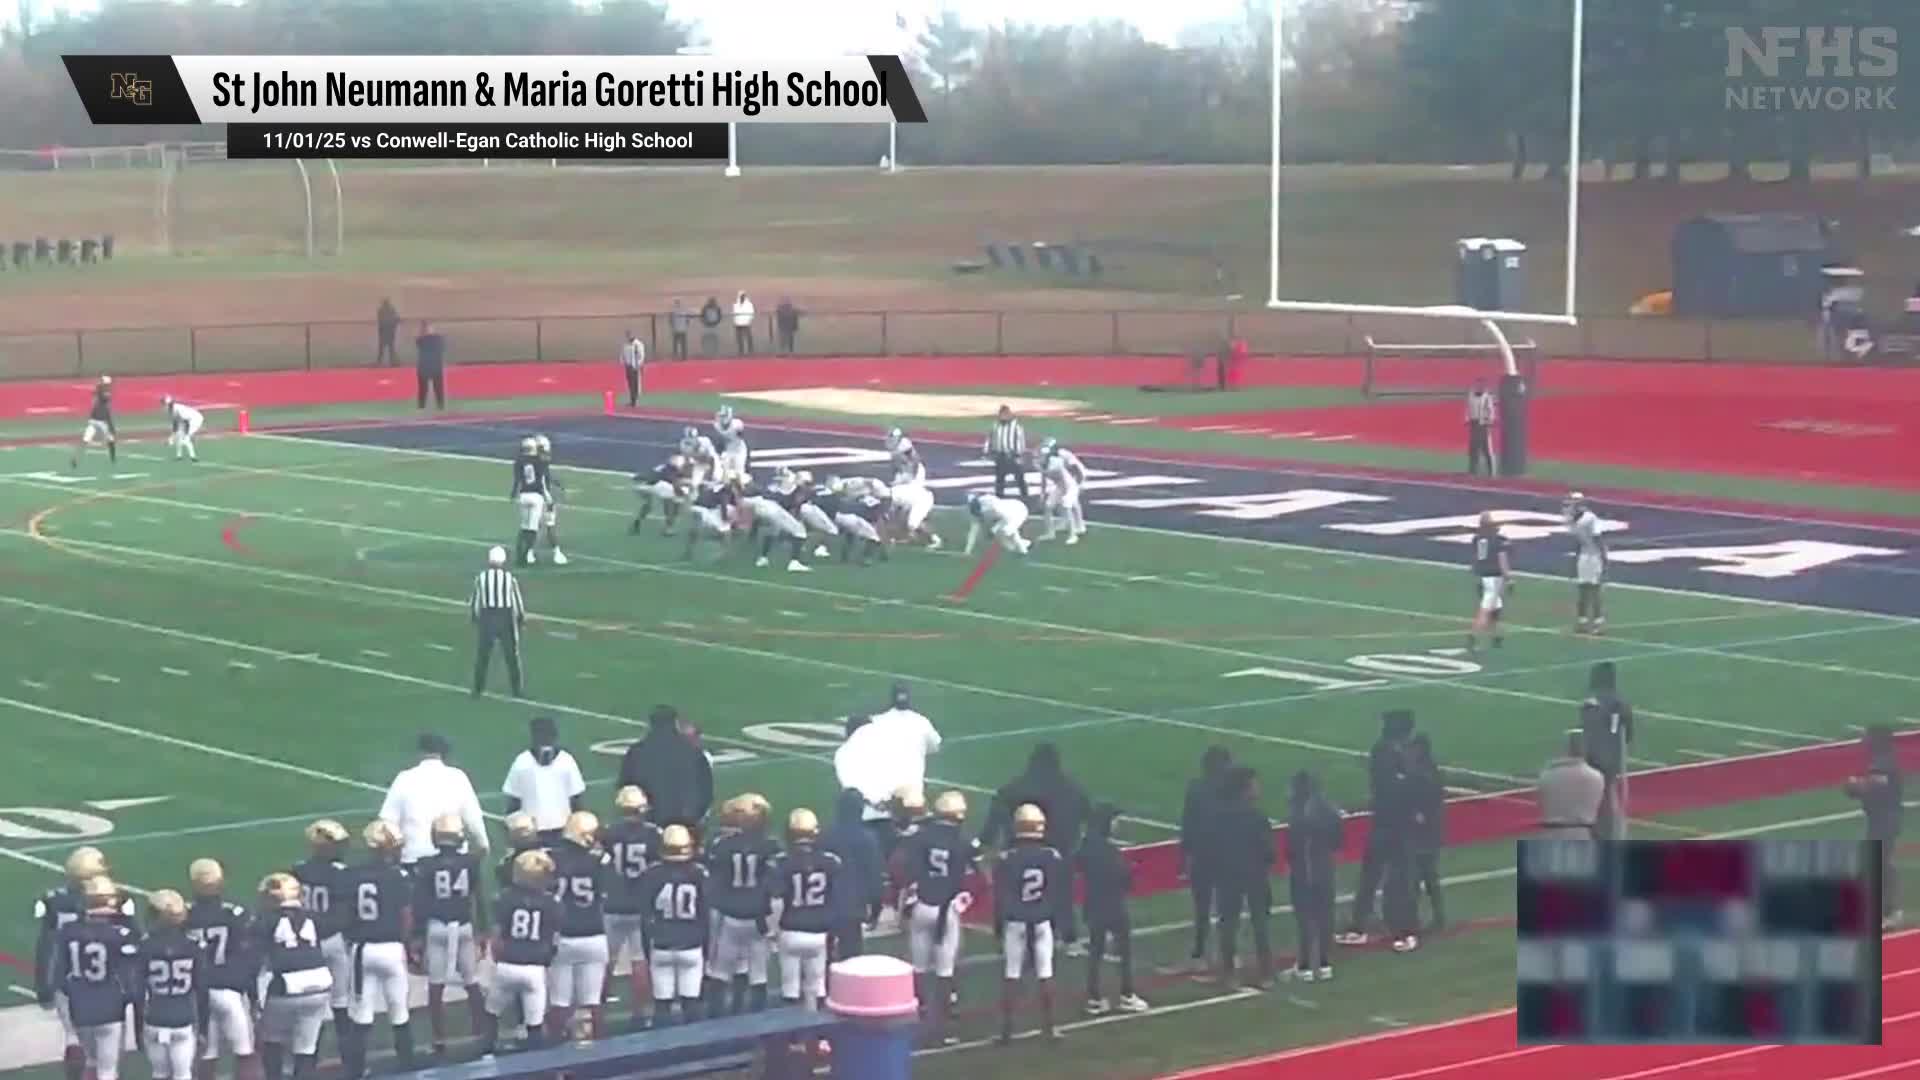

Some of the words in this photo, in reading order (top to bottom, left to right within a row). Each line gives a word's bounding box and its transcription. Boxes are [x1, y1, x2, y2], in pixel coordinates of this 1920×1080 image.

[613, 843, 647, 879] 15
[732, 852, 757, 888] 11
[930, 849, 950, 878] 5
[433, 867, 470, 899] 84
[656, 882, 698, 919] 40
[792, 872, 828, 907] 12
[1022, 868, 1045, 902] 2
[357, 882, 379, 921] 6
[273, 916, 318, 948] 44
[511, 908, 541, 941] 81
[66, 940, 108, 981] 13
[149, 958, 194, 995] 25
